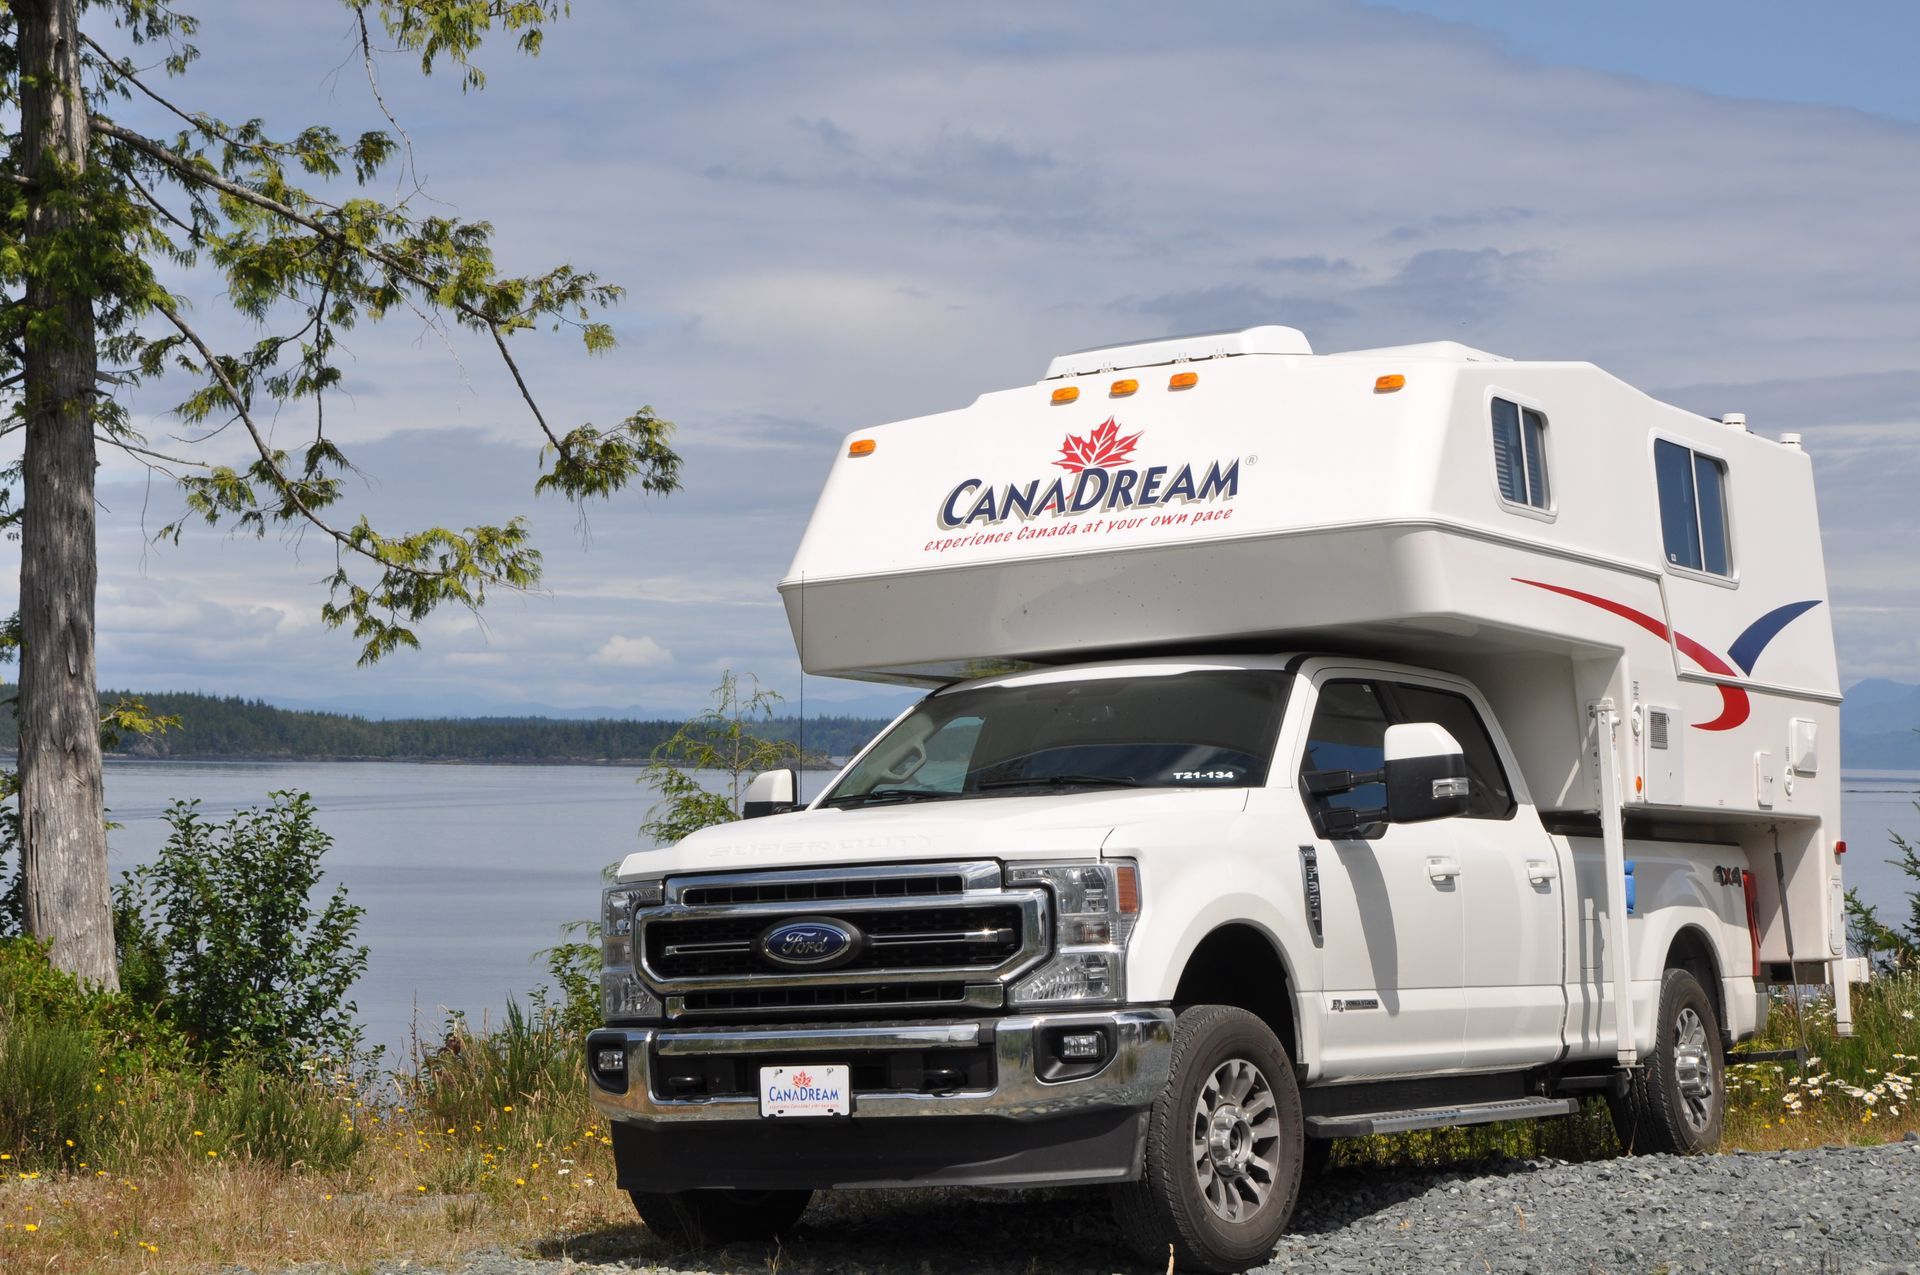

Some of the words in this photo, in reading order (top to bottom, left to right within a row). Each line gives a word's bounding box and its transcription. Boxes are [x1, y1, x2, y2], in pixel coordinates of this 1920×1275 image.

[924, 531, 1013, 552] experience
[1017, 522, 1077, 540] Canada
[1082, 519, 1103, 534] at
[1106, 516, 1147, 533] your
[1151, 512, 1188, 527] own
[1191, 508, 1233, 526] pace
[1173, 771, 1234, 780] T21-134
[782, 931, 829, 955] Ford
